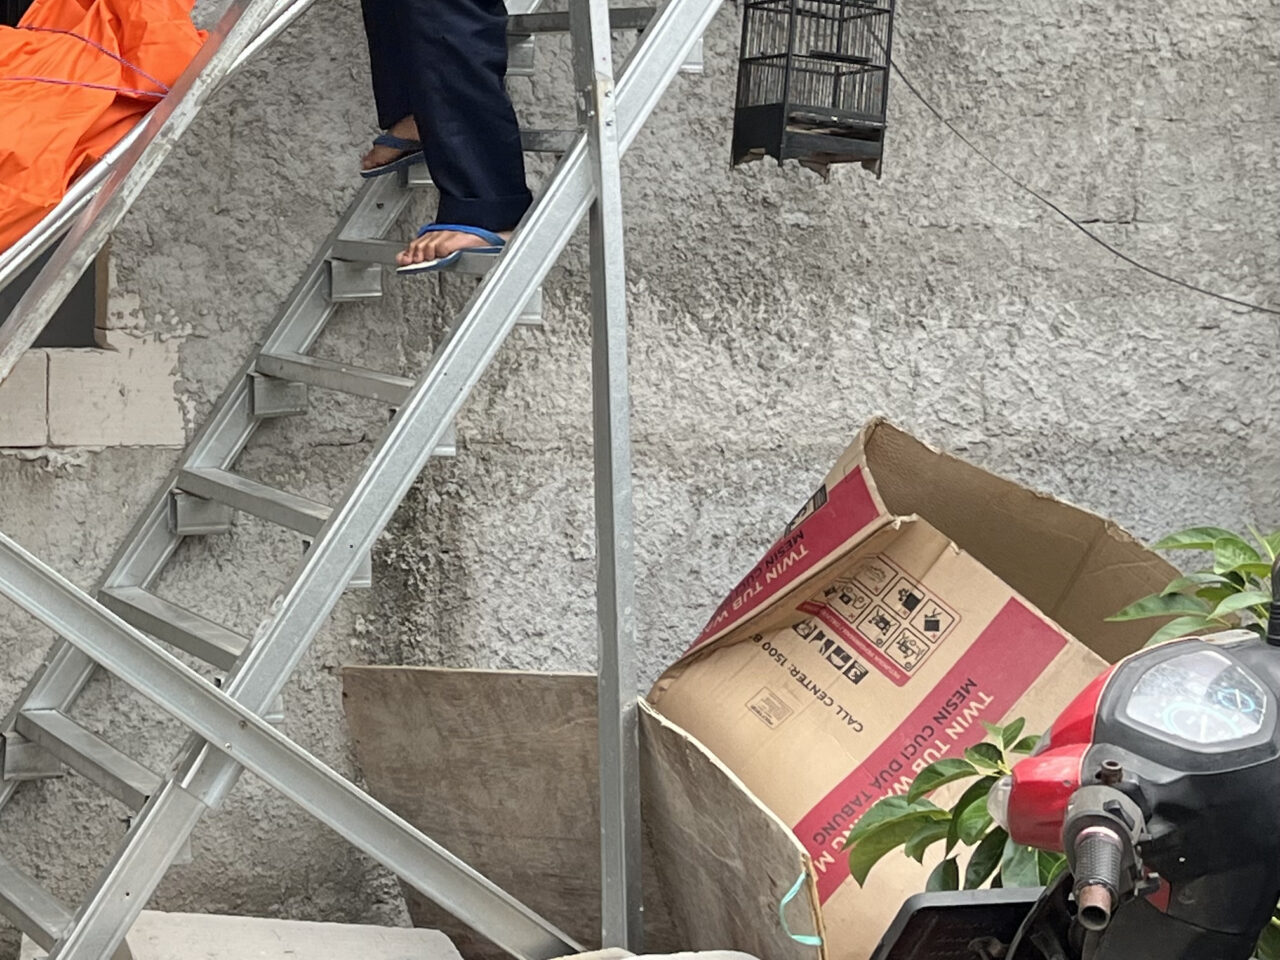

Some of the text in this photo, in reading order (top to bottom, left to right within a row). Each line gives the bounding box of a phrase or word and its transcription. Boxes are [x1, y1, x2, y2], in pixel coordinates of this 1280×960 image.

[765, 529, 805, 569] MESIN
[765, 543, 810, 584] TWIN
[732, 584, 764, 610] TUB
[761, 641, 788, 667] 1500
[787, 663, 835, 706] CENTER:
[933, 677, 978, 726] MESIN
[835, 704, 864, 733] CALL
[944, 691, 994, 740] TWIN
[900, 725, 935, 761] CUCI
[911, 739, 951, 775] TUB
[870, 759, 903, 791] DUA
[812, 790, 873, 846] TABUNG
